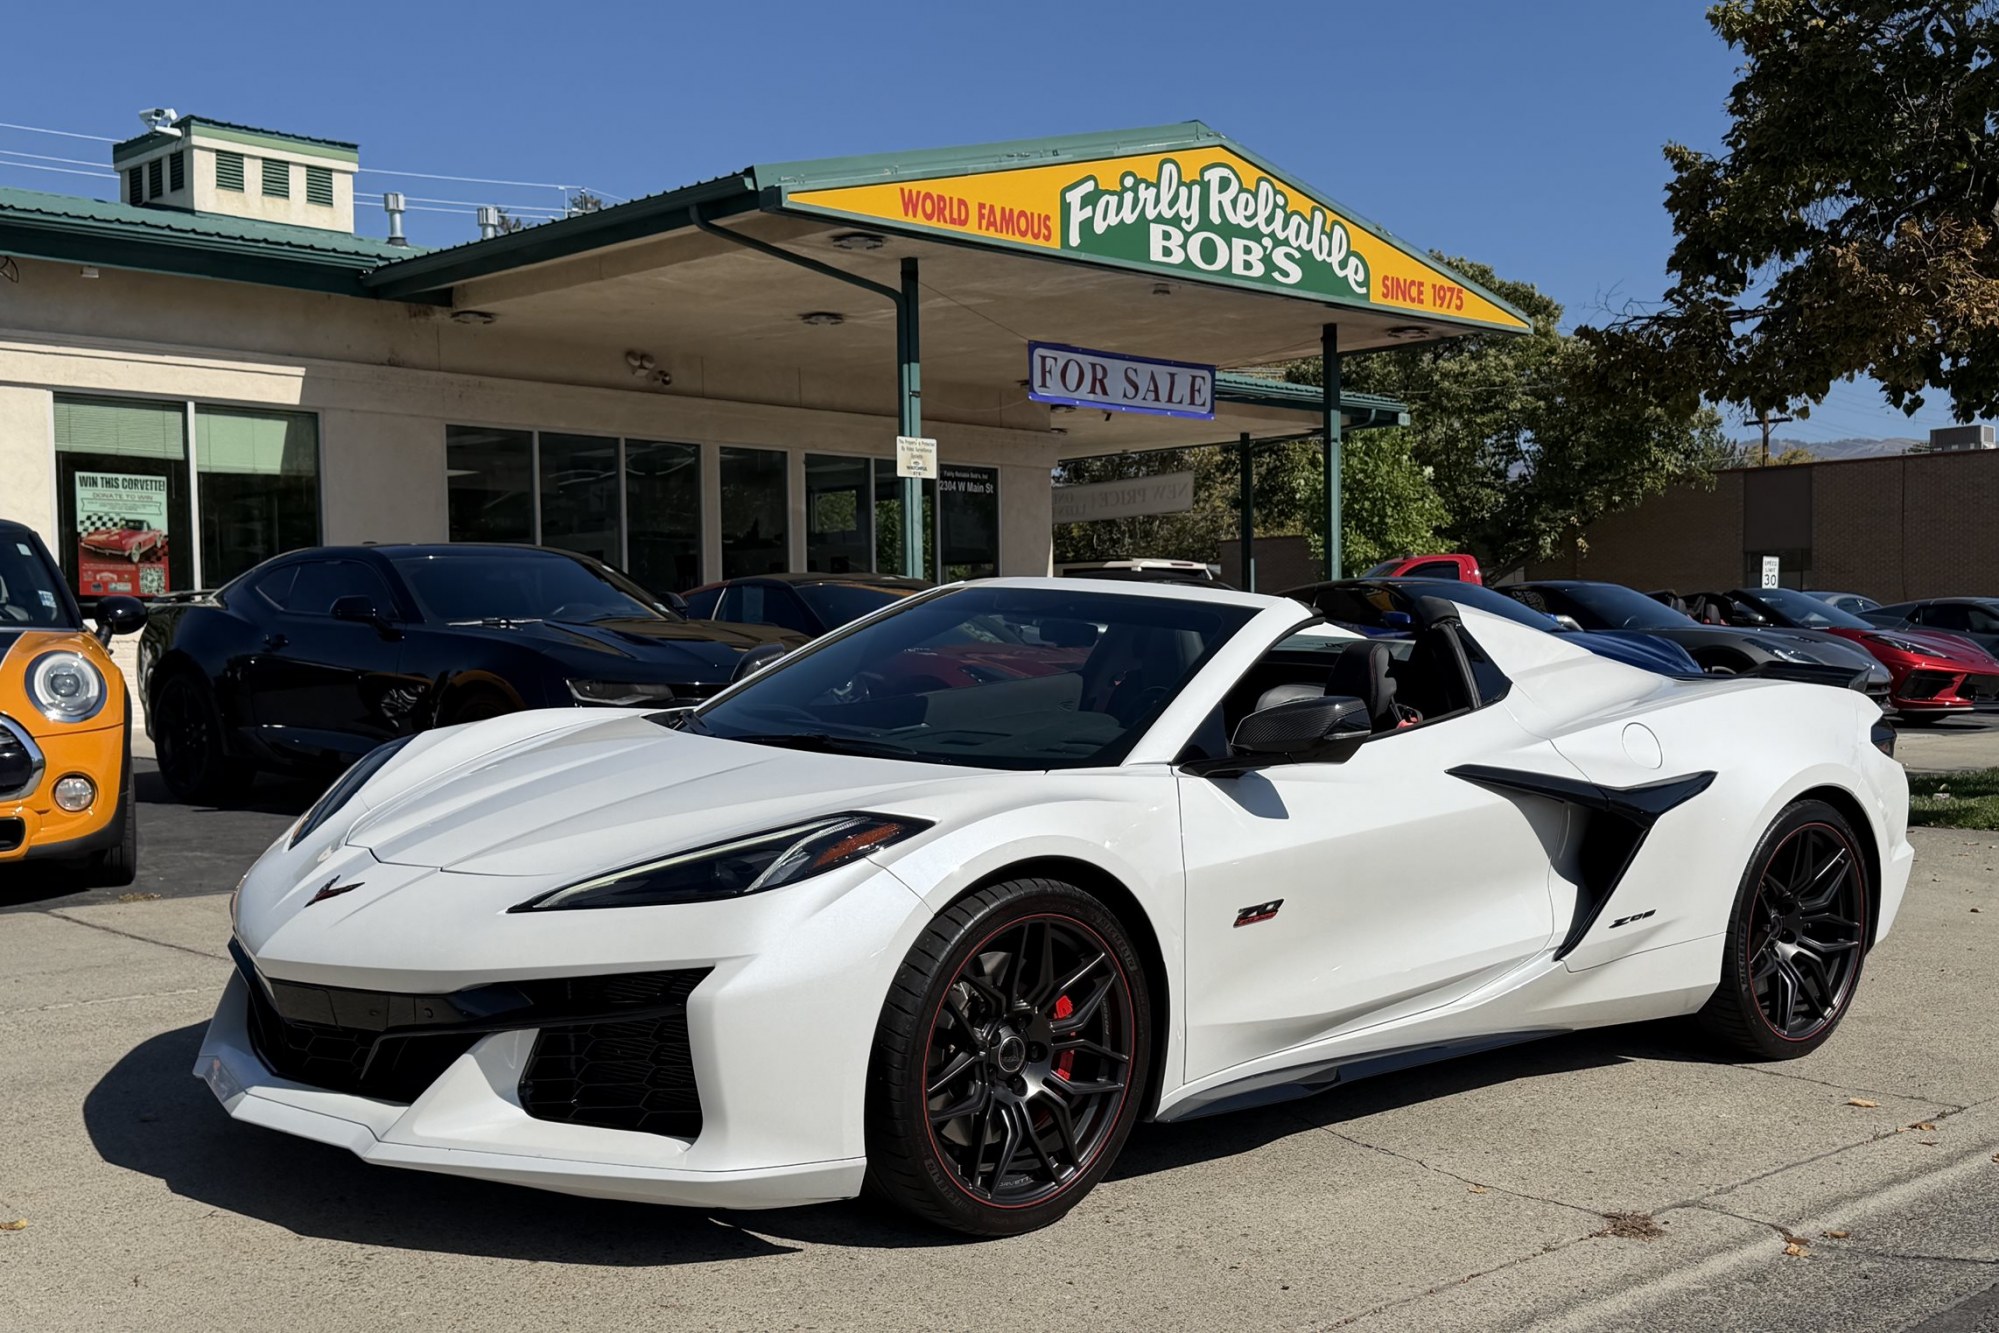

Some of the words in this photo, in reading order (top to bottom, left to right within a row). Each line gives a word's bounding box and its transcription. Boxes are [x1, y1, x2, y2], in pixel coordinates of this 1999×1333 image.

[900, 186, 969, 227] WORLD
[977, 202, 1052, 242] FAMOUS
[1065, 163, 1201, 247] Fairly
[1203, 167, 1368, 294] Reliable
[1149, 222, 1303, 285] BOB'S
[1381, 275, 1424, 305] SINCE
[1431, 283, 1464, 312] 1975
[1038, 354, 1109, 397] FOR
[1122, 366, 1207, 407] SALE
[79, 475, 98, 489] WIN
[99, 476, 120, 490] THIS
[121, 478, 165, 492] CORVETTE!
[92, 492, 123, 500] DONATE
[939, 479, 957, 492] 2304
[957, 481, 966, 492] W
[967, 481, 984, 493] Main
[985, 482, 994, 494] St
[1764, 574, 1777, 586] 30
